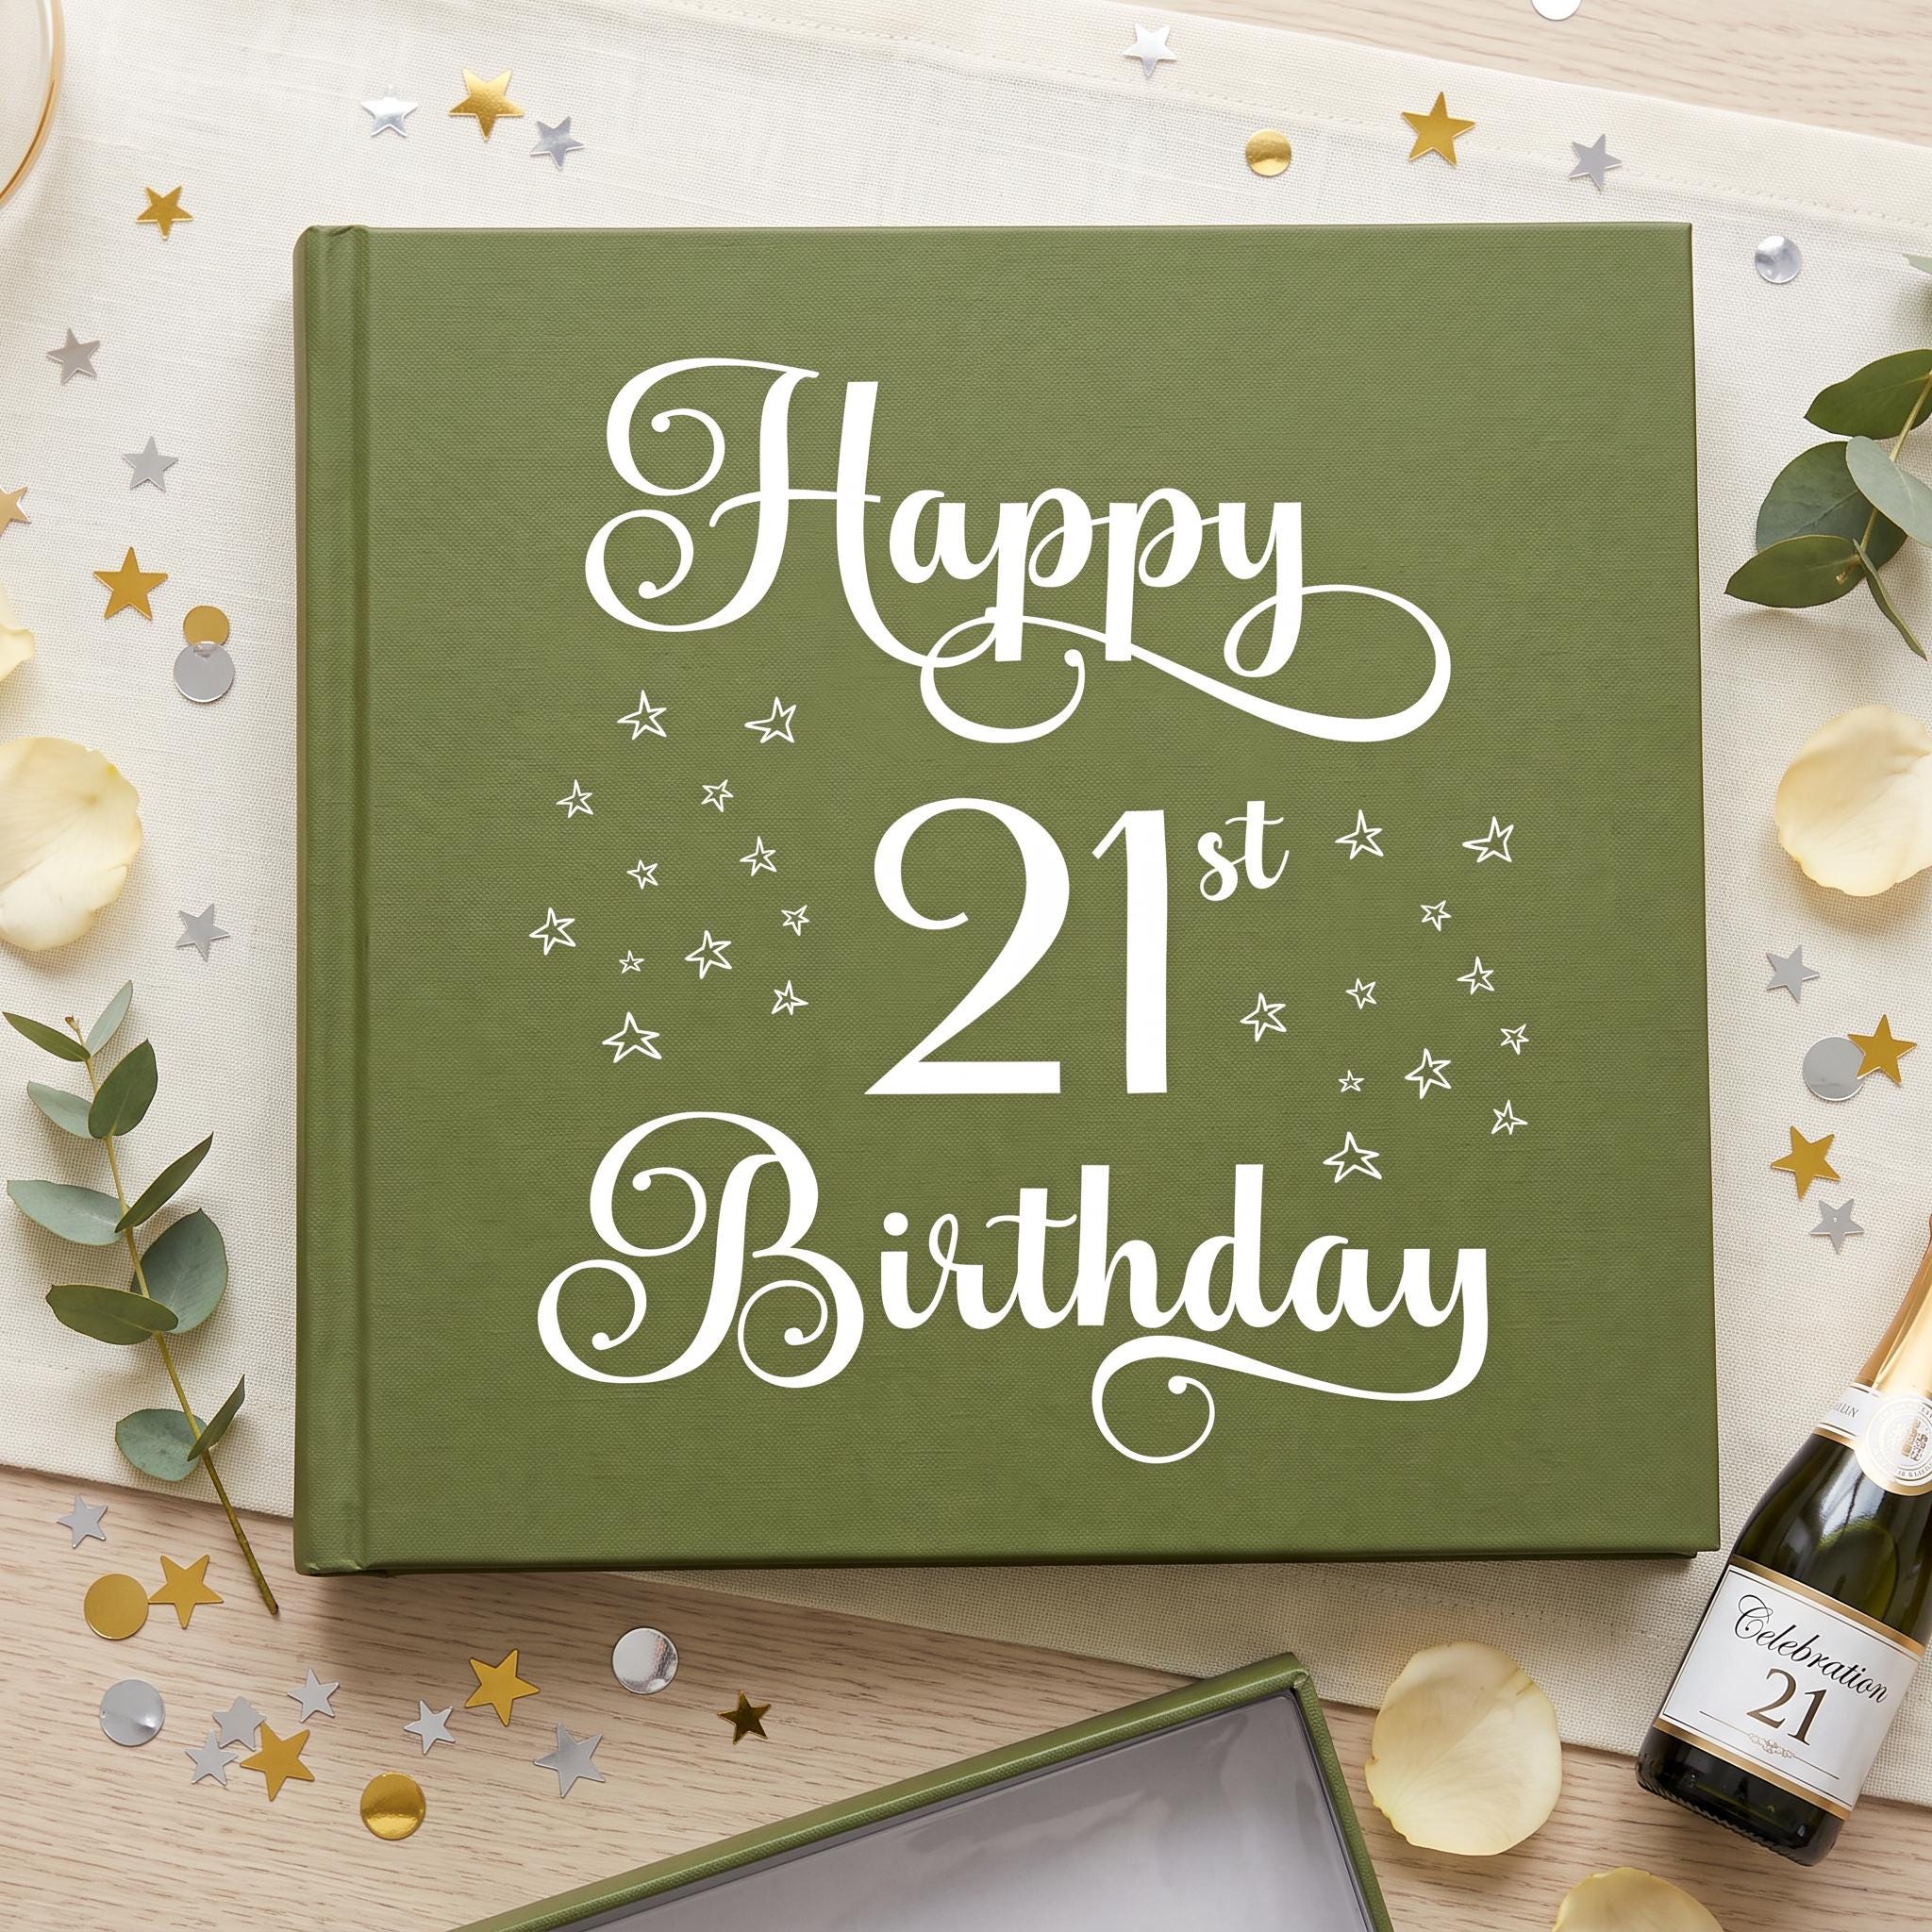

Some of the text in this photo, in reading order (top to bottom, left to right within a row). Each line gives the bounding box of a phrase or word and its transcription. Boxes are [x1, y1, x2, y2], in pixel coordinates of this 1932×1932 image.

[585, 358, 1451, 743] Happy
[865, 798, 1290, 1094] 21st
[538, 1112, 1489, 1464] Birthday
[1734, 1594, 1888, 1704] Celebration
[1746, 1668, 1827, 1746] 21
